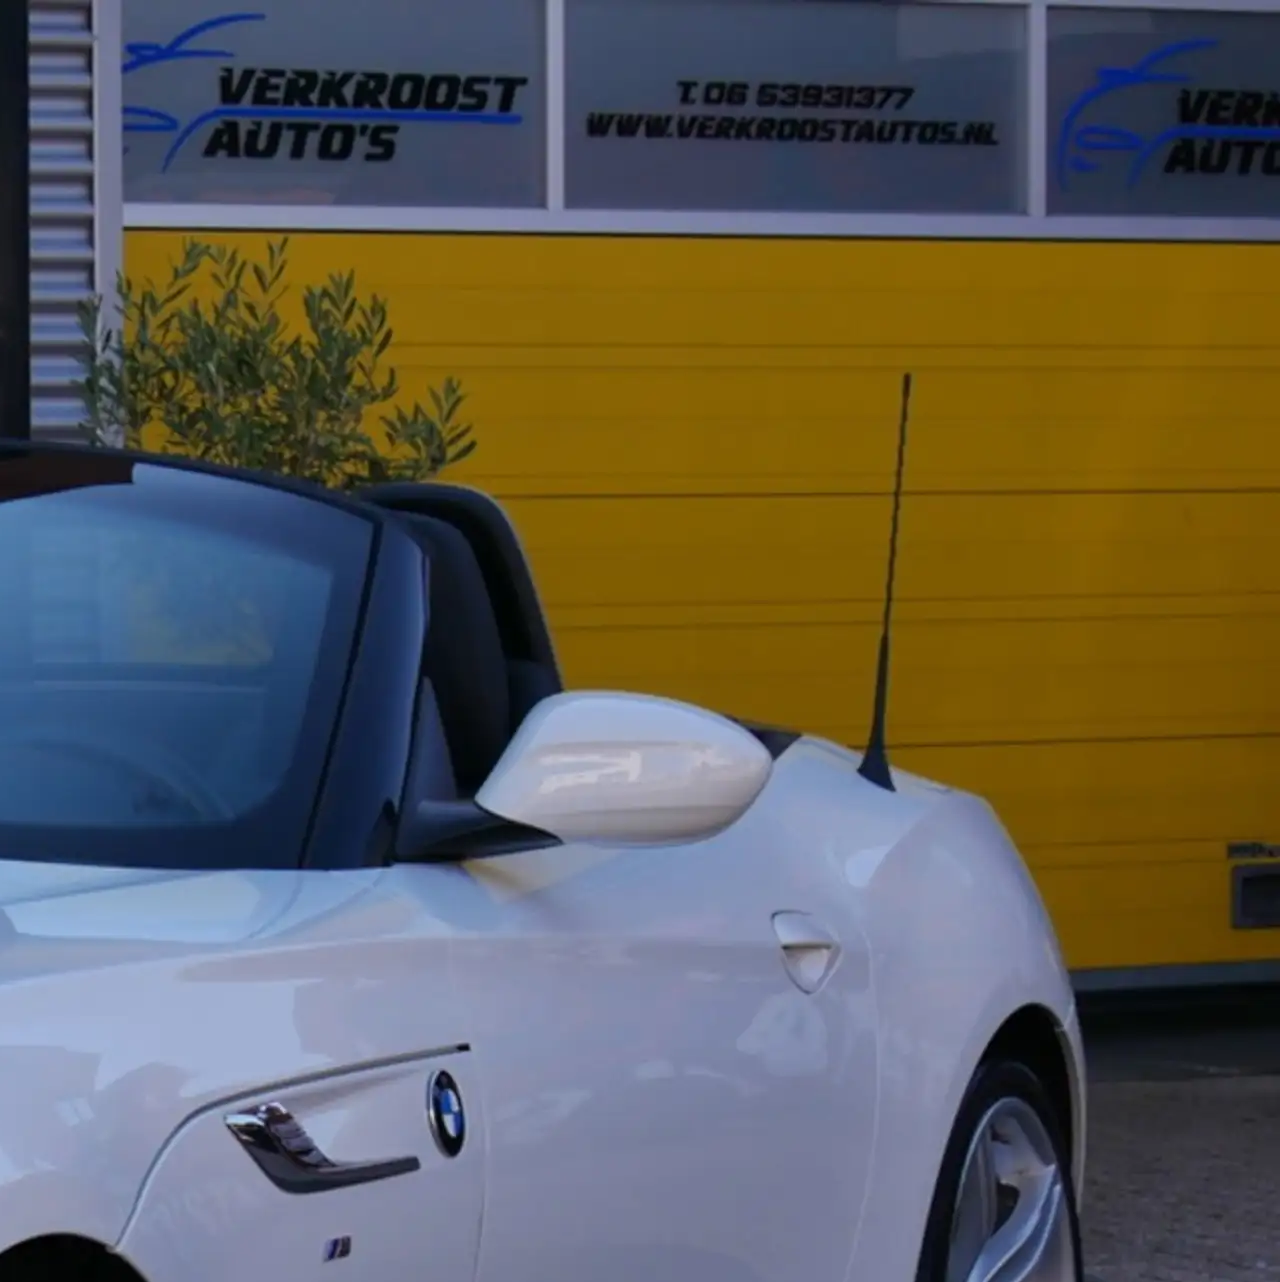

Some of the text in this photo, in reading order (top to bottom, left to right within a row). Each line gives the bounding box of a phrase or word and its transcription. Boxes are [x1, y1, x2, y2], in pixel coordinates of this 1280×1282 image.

[218, 67, 528, 113] VERKROOST
[756, 82, 916, 110] 53931377
[202, 119, 400, 163] AUTO'S
[586, 112, 999, 146] WWW.VERKROOSTAUTOS.NL
